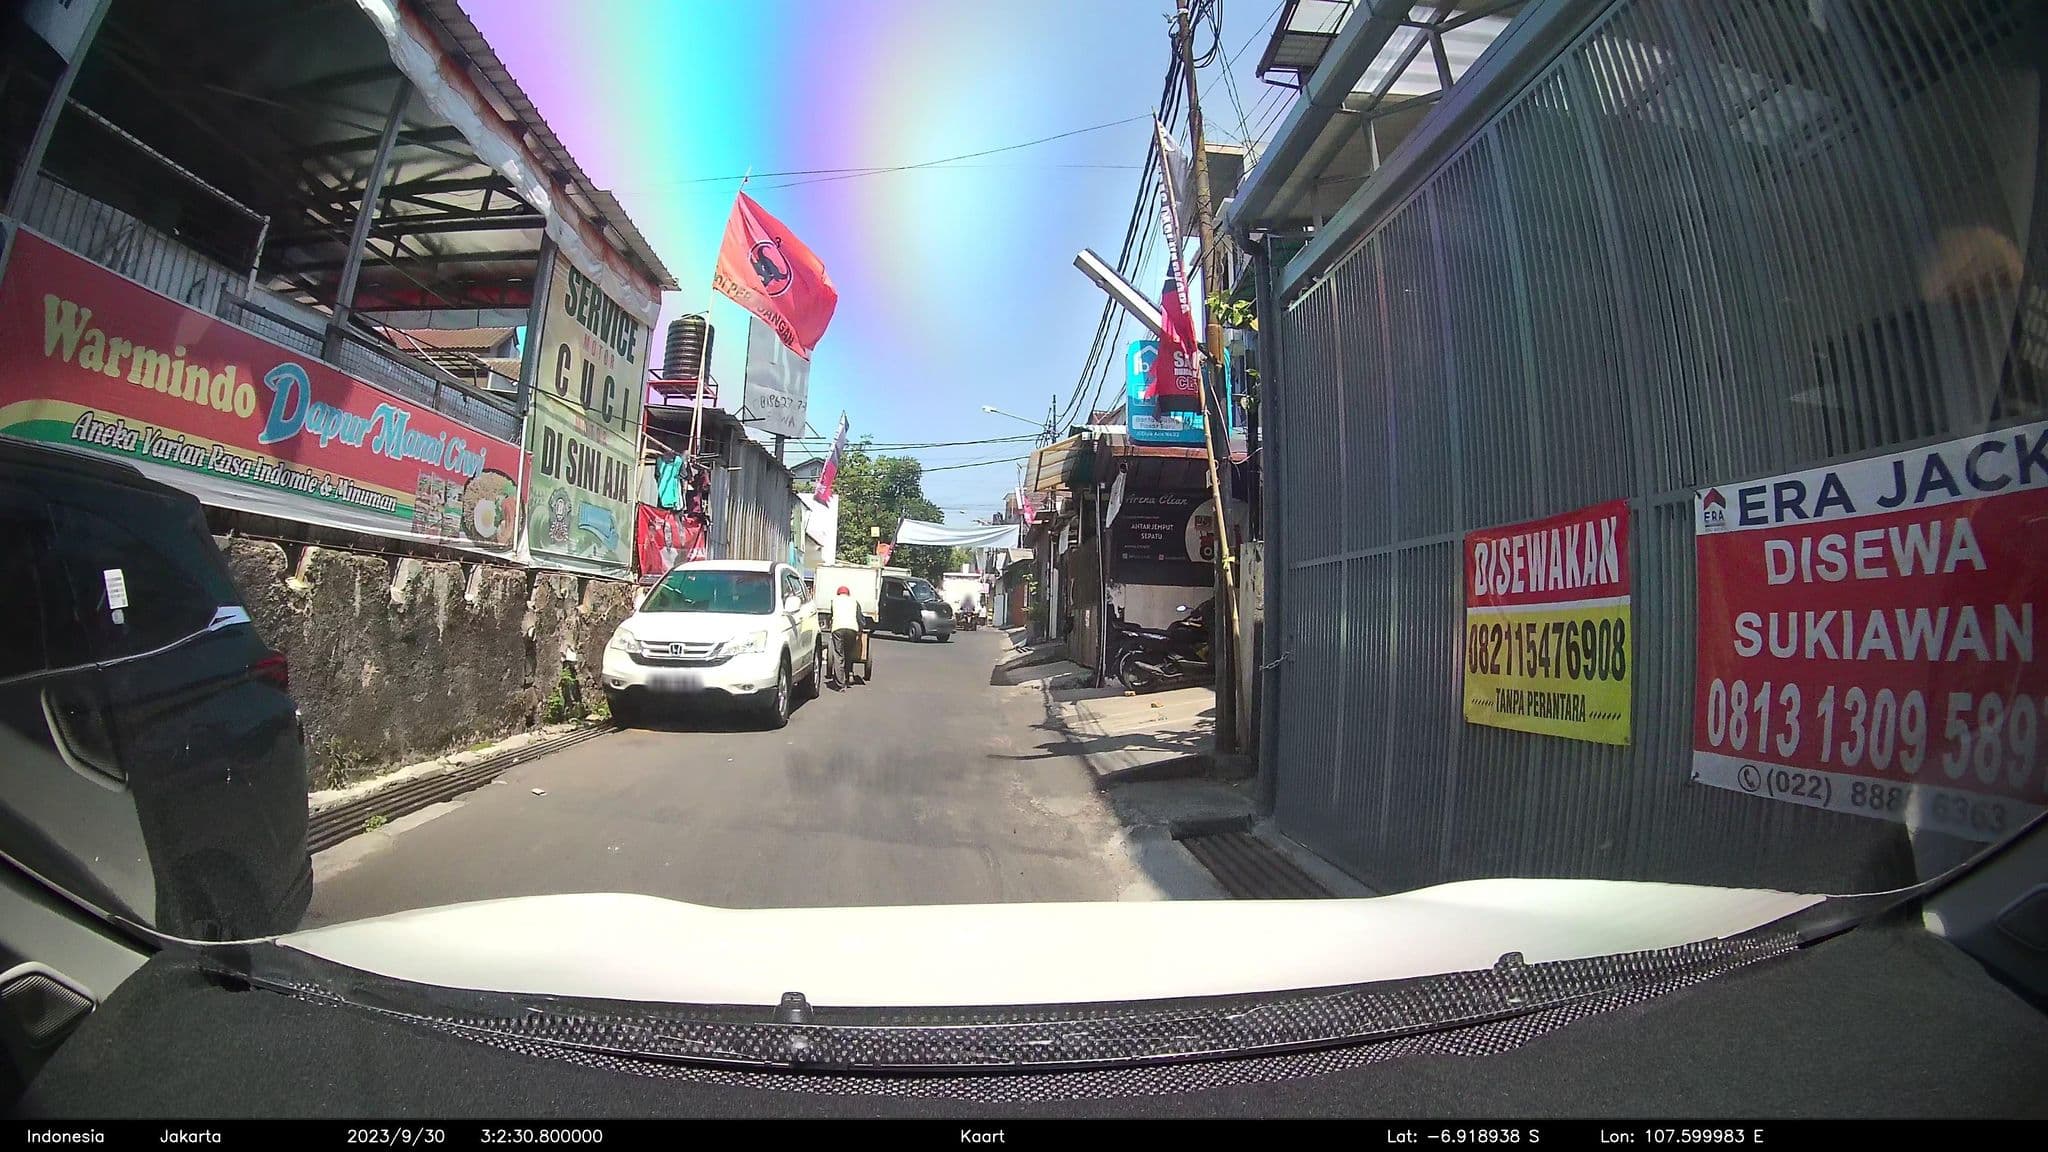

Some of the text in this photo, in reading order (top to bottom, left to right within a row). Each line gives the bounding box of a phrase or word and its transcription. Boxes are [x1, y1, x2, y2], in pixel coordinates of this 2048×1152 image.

[564, 264, 639, 365] SERVICE
[43, 293, 257, 419] Warmindo
[258, 362, 372, 448] Dapur
[444, 436, 487, 478] Ciwi
[555, 343, 630, 432] CUCI
[71, 411, 398, 512] Aneka Varian Rasa Indomie & Minuman
[540, 425, 563, 480] DI
[565, 437, 602, 494] SINI
[602, 455, 629, 504] AJA
[1739, 429, 2048, 526] ERA JACK
[1140, 532, 1163, 540] SEPATU
[1704, 510, 1725, 522] ERA
[1764, 517, 1987, 586] DISEWA
[1474, 516, 1620, 596] DISEWAKAN
[1469, 617, 1627, 682] 082115476908
[1733, 603, 2034, 662] SUKIAWAN
[1495, 688, 1586, 723] TANPA PERANTARA
[1707, 678, 2048, 789] 0813 1309 589
[1766, 768, 1833, 808] (022)
